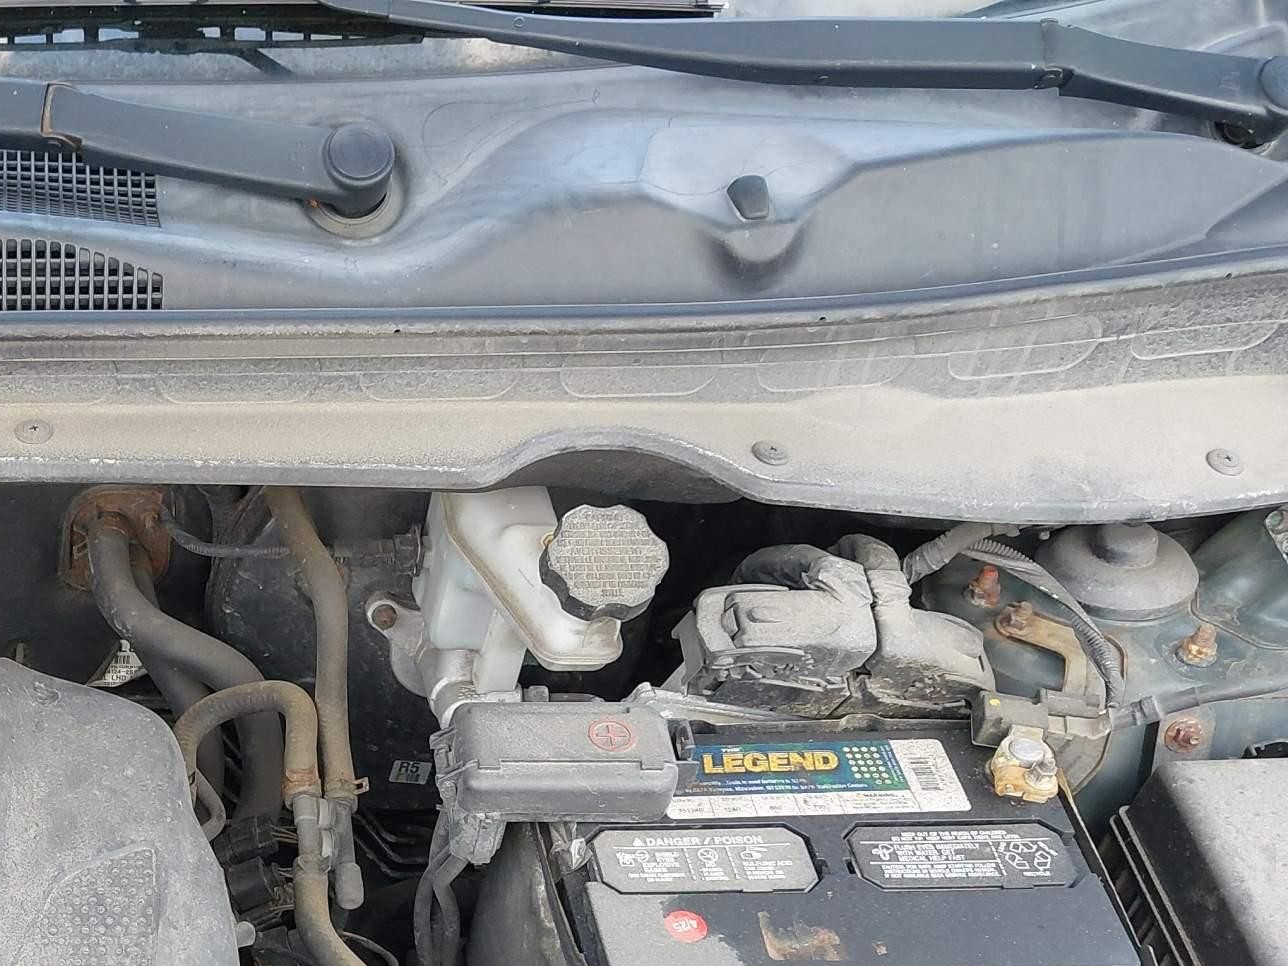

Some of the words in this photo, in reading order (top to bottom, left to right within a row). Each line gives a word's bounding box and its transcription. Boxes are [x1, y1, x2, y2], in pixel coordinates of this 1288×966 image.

[399, 761, 421, 774] R5
[702, 750, 840, 775] LEGEND
[646, 836, 702, 846] DANGER
[713, 835, 764, 845] POISON
